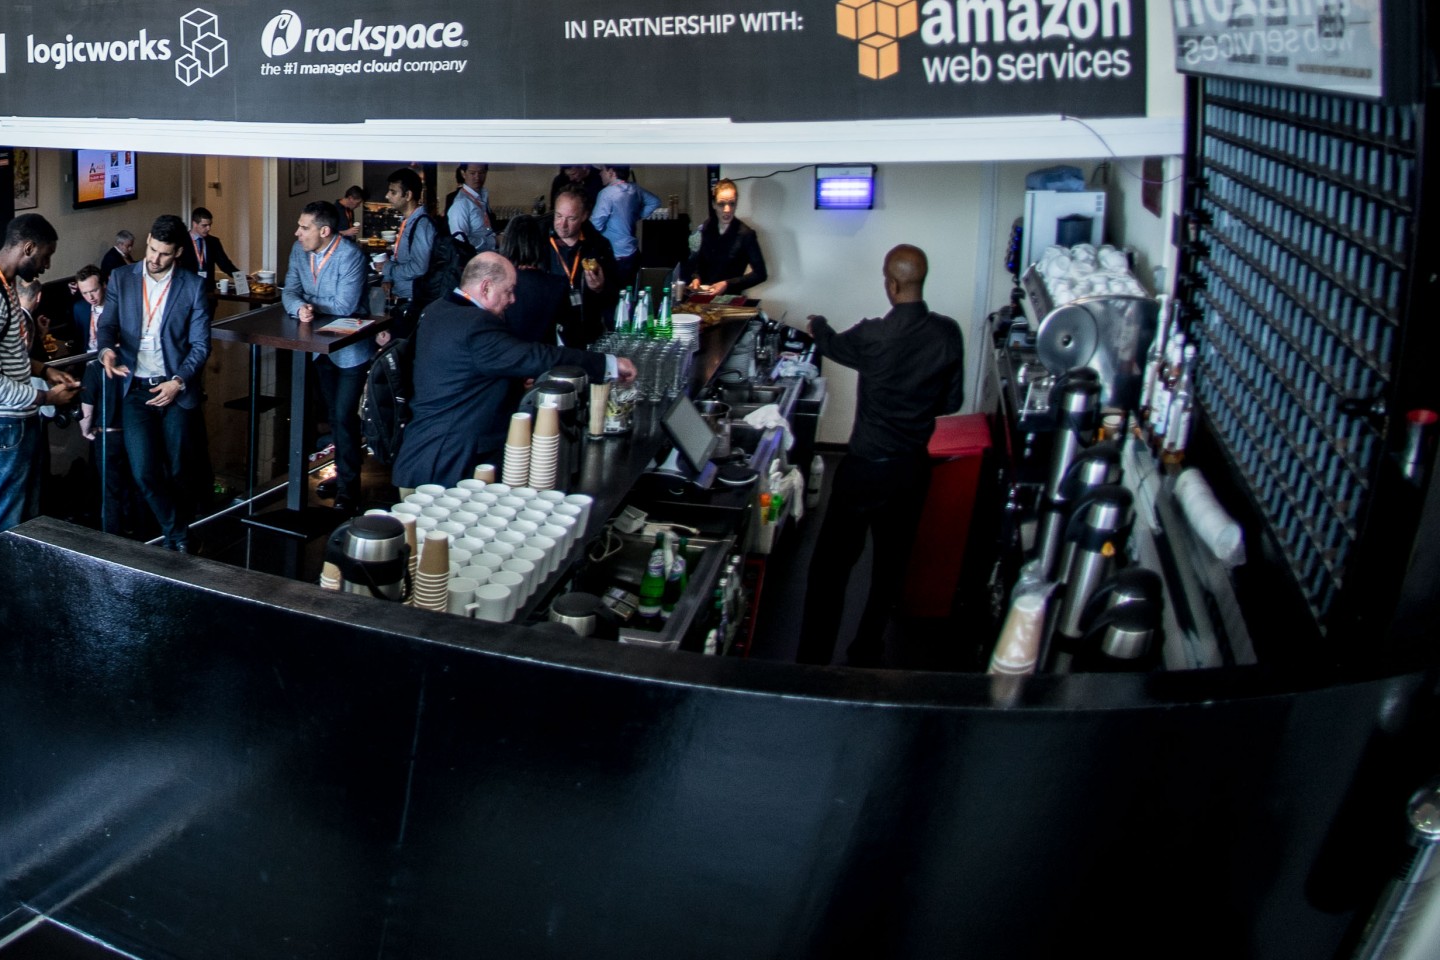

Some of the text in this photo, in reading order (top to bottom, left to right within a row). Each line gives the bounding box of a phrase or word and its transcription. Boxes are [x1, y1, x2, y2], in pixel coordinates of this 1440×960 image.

[564, 10, 804, 38] IN PARTNERSHIP WITH:
[26, 28, 172, 70] logicworks
[923, 44, 1131, 83] web services
[260, 58, 467, 76] the #1 managed cloud company
